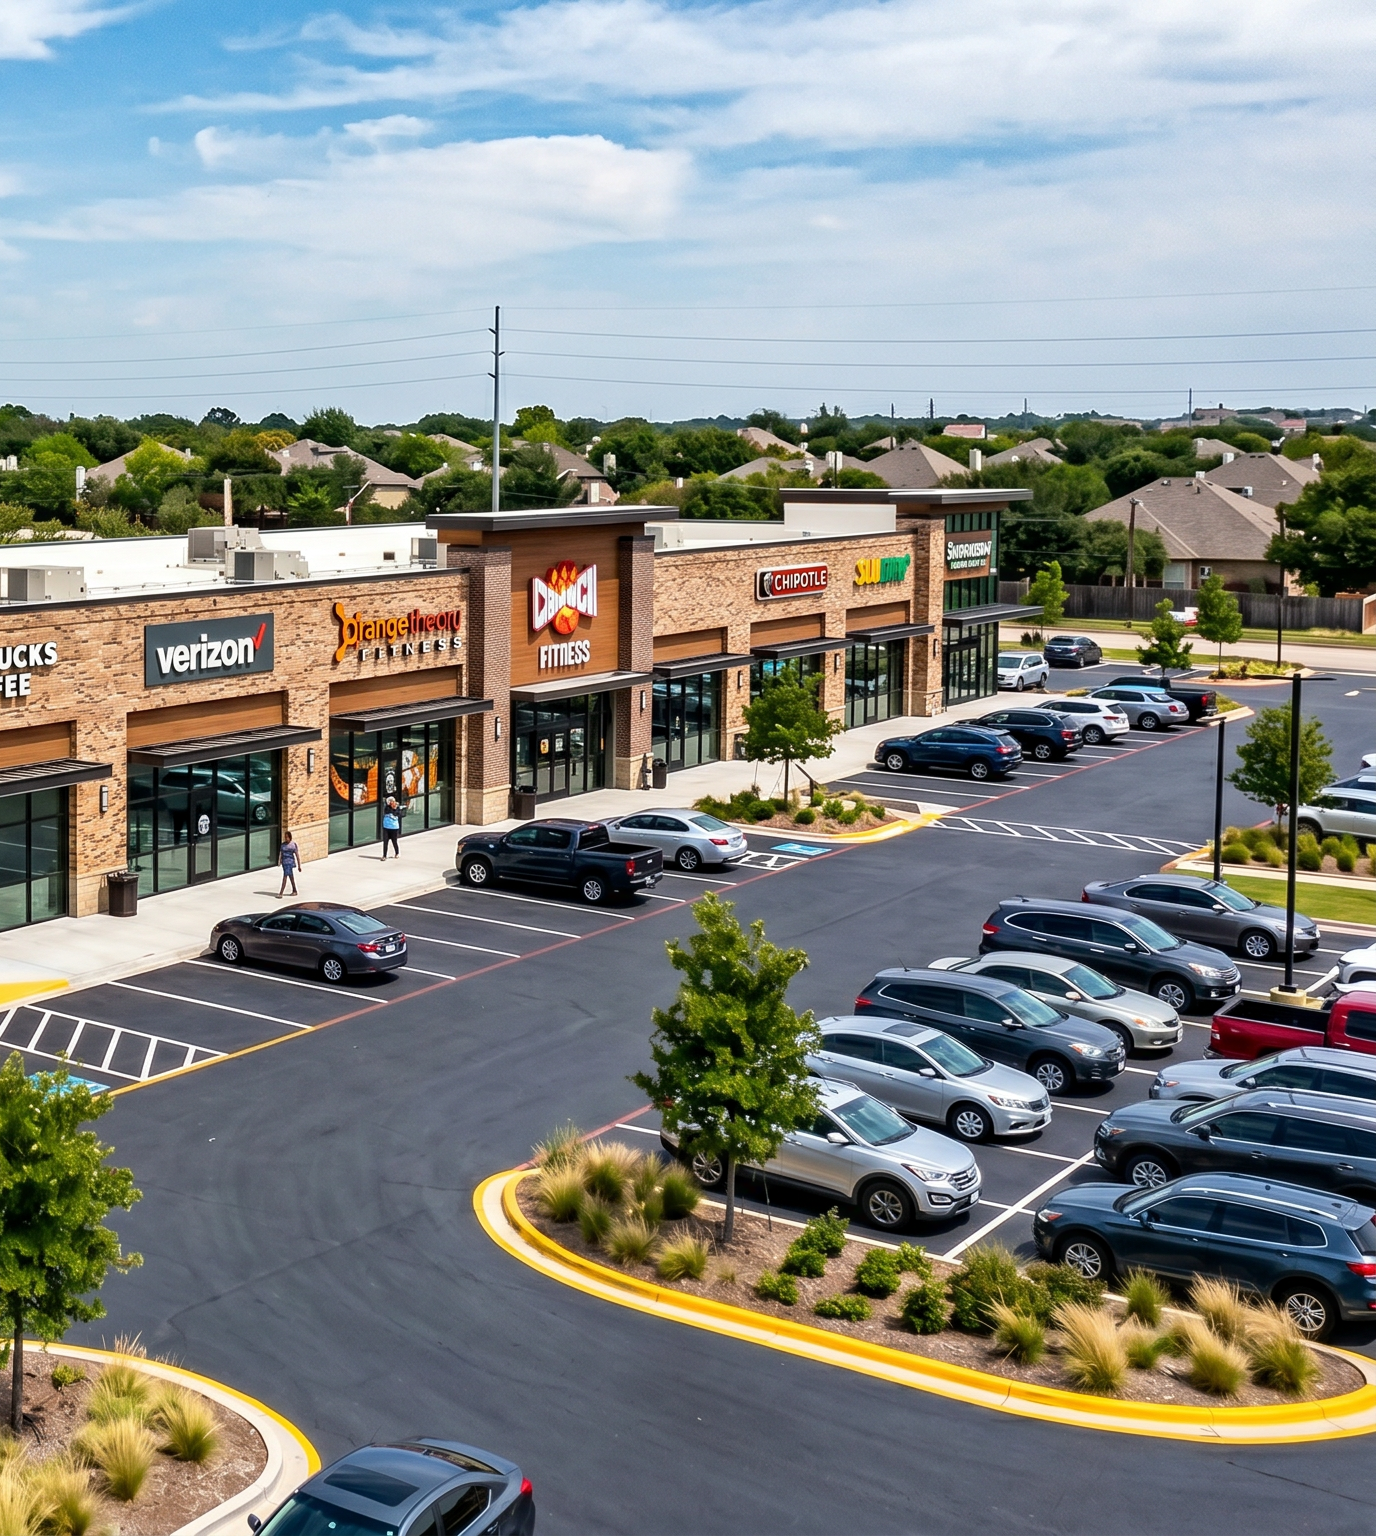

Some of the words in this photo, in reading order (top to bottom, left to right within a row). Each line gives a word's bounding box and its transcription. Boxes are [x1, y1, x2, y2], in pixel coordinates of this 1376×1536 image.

[774, 569, 827, 591] CHIPOTLE
[156, 633, 254, 674] verizon
[539, 639, 591, 669] FITNESS
